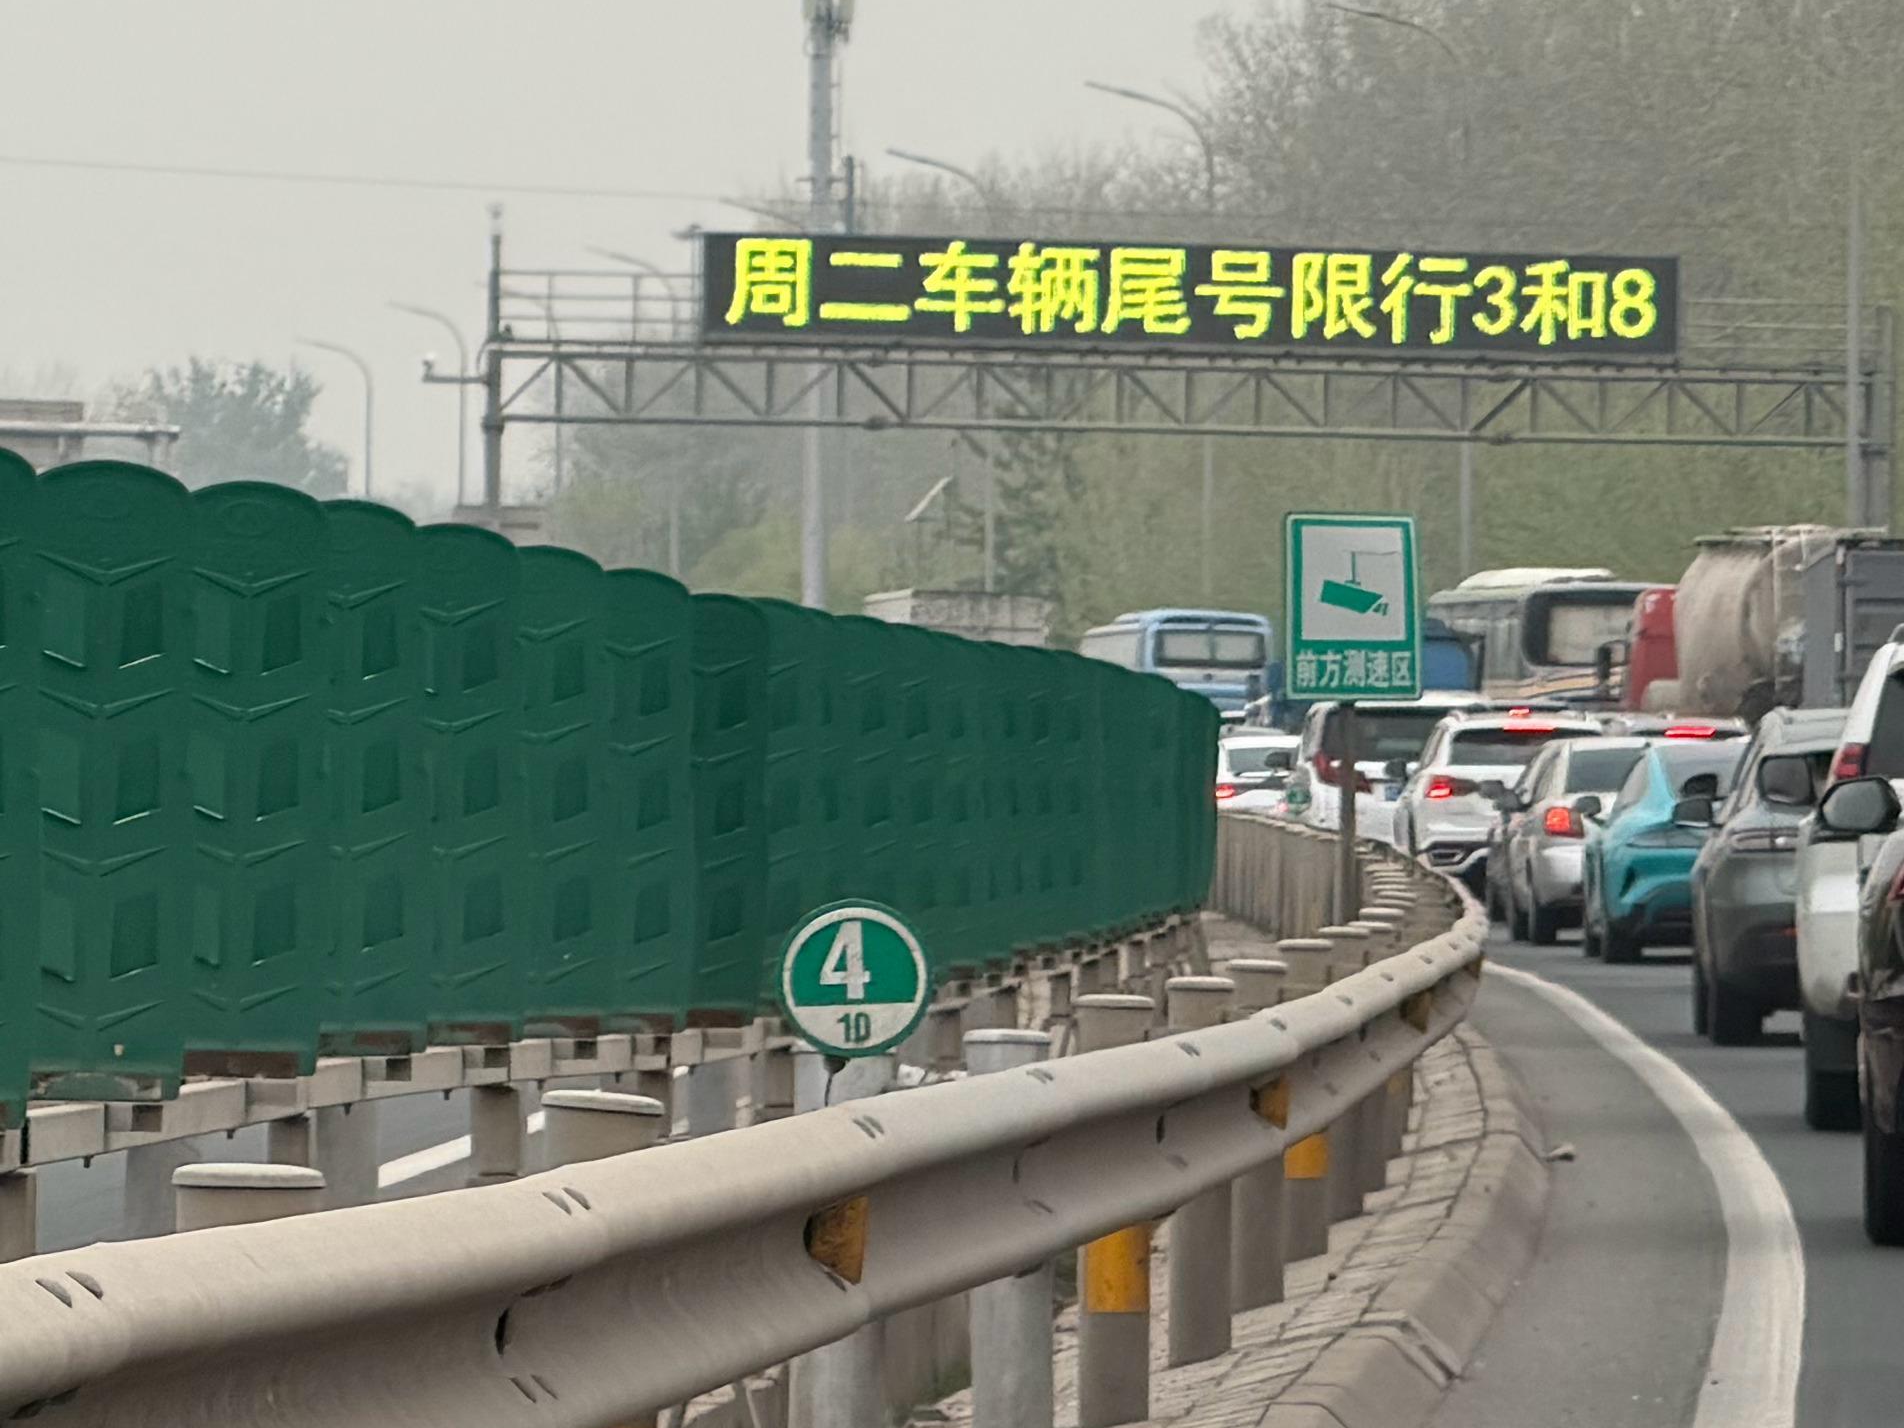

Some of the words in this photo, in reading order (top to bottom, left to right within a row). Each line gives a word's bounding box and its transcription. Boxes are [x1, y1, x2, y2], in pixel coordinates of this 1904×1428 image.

[725, 236, 1658, 346] 周二车辆尾号限行3和8
[1295, 649, 1413, 688] 前方测速区
[819, 920, 871, 1000] 4
[837, 1011, 872, 1044] 10
